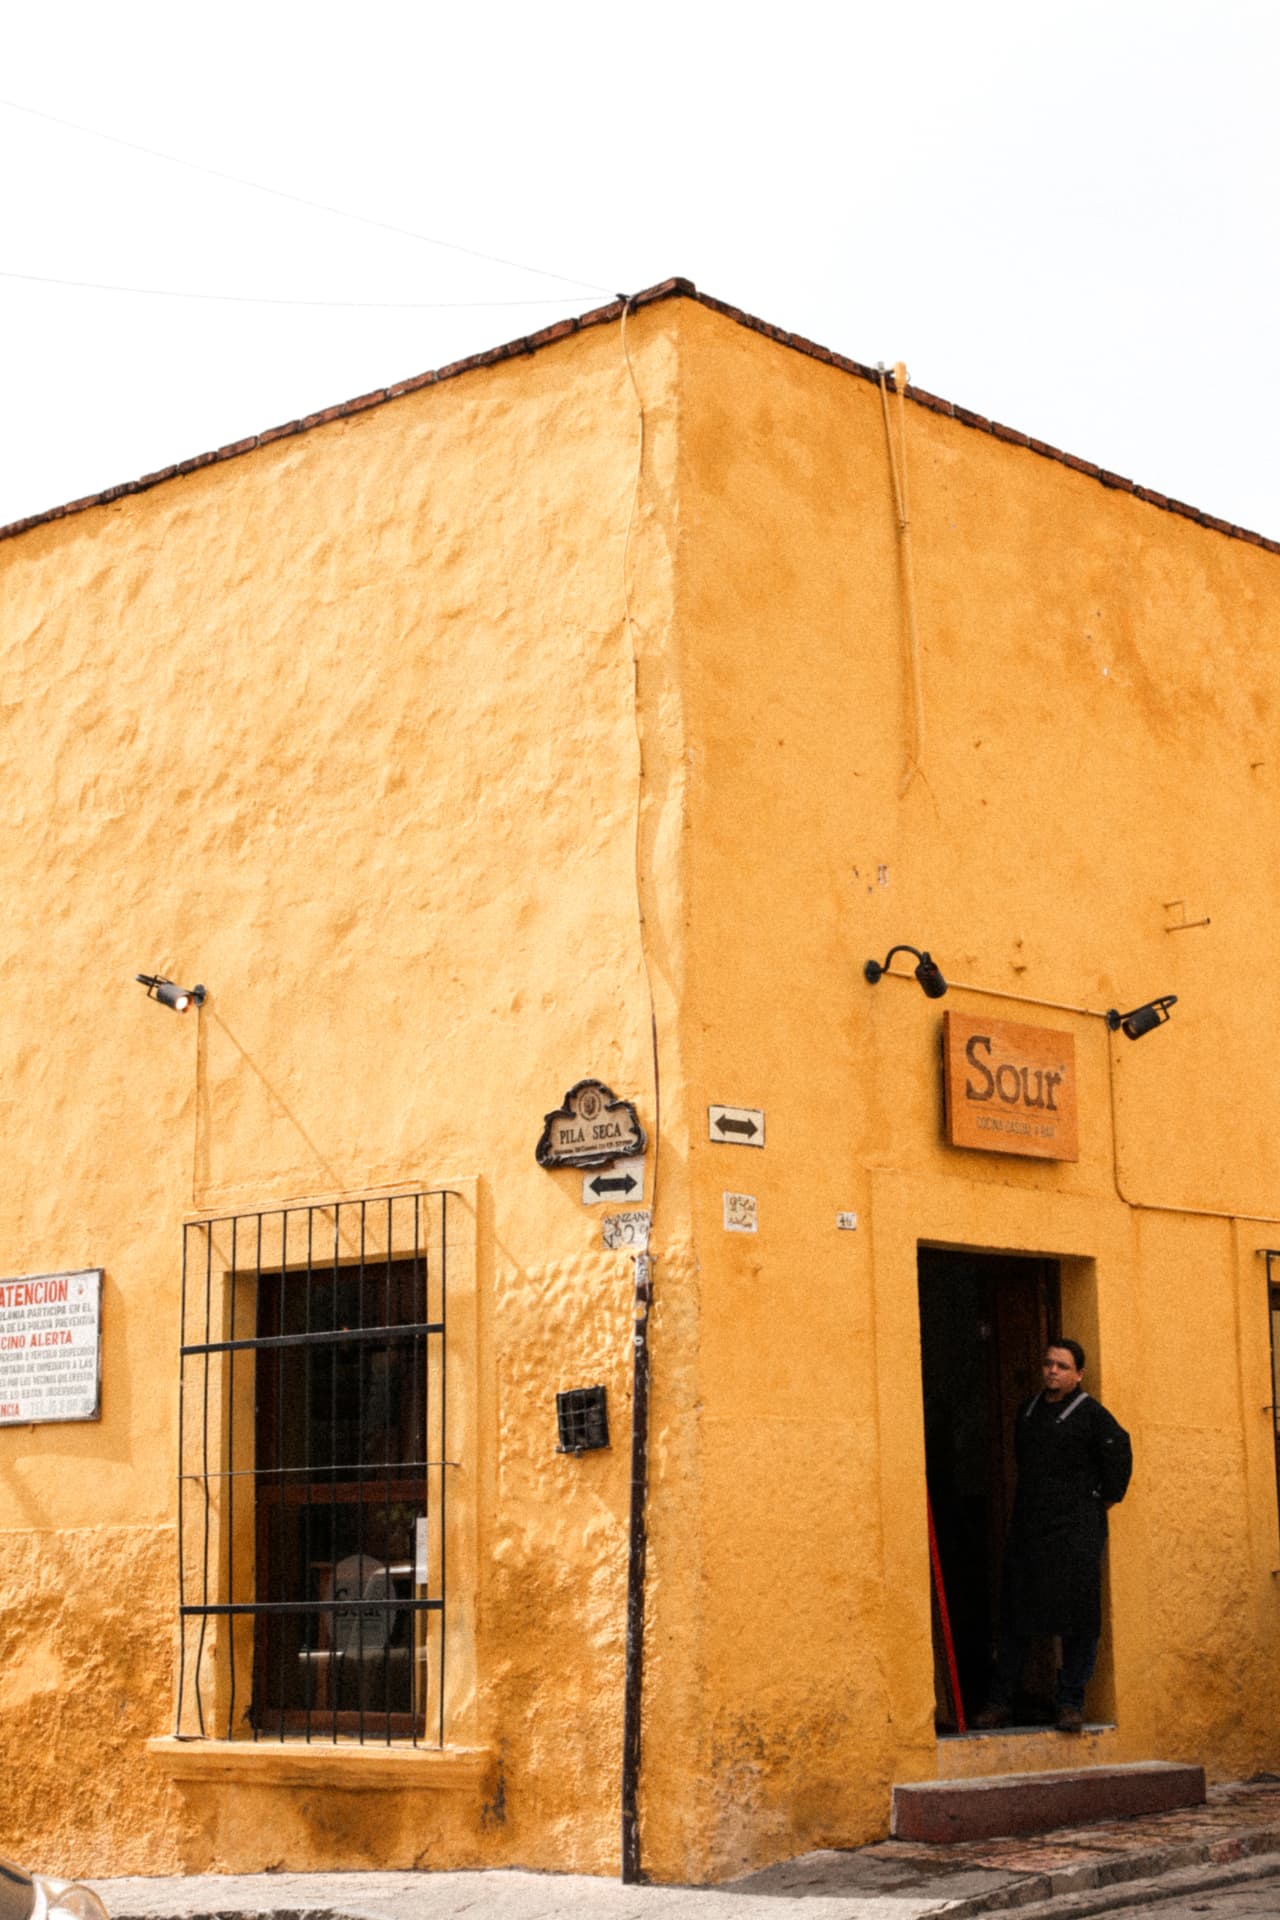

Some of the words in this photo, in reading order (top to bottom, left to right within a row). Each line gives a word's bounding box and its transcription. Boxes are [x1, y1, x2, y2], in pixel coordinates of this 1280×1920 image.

[966, 1035, 1061, 1111] Sour
[560, 1128, 585, 1145] PILA
[592, 1122, 622, 1140] SECA
[30, 1330, 73, 1347] ALERTA
